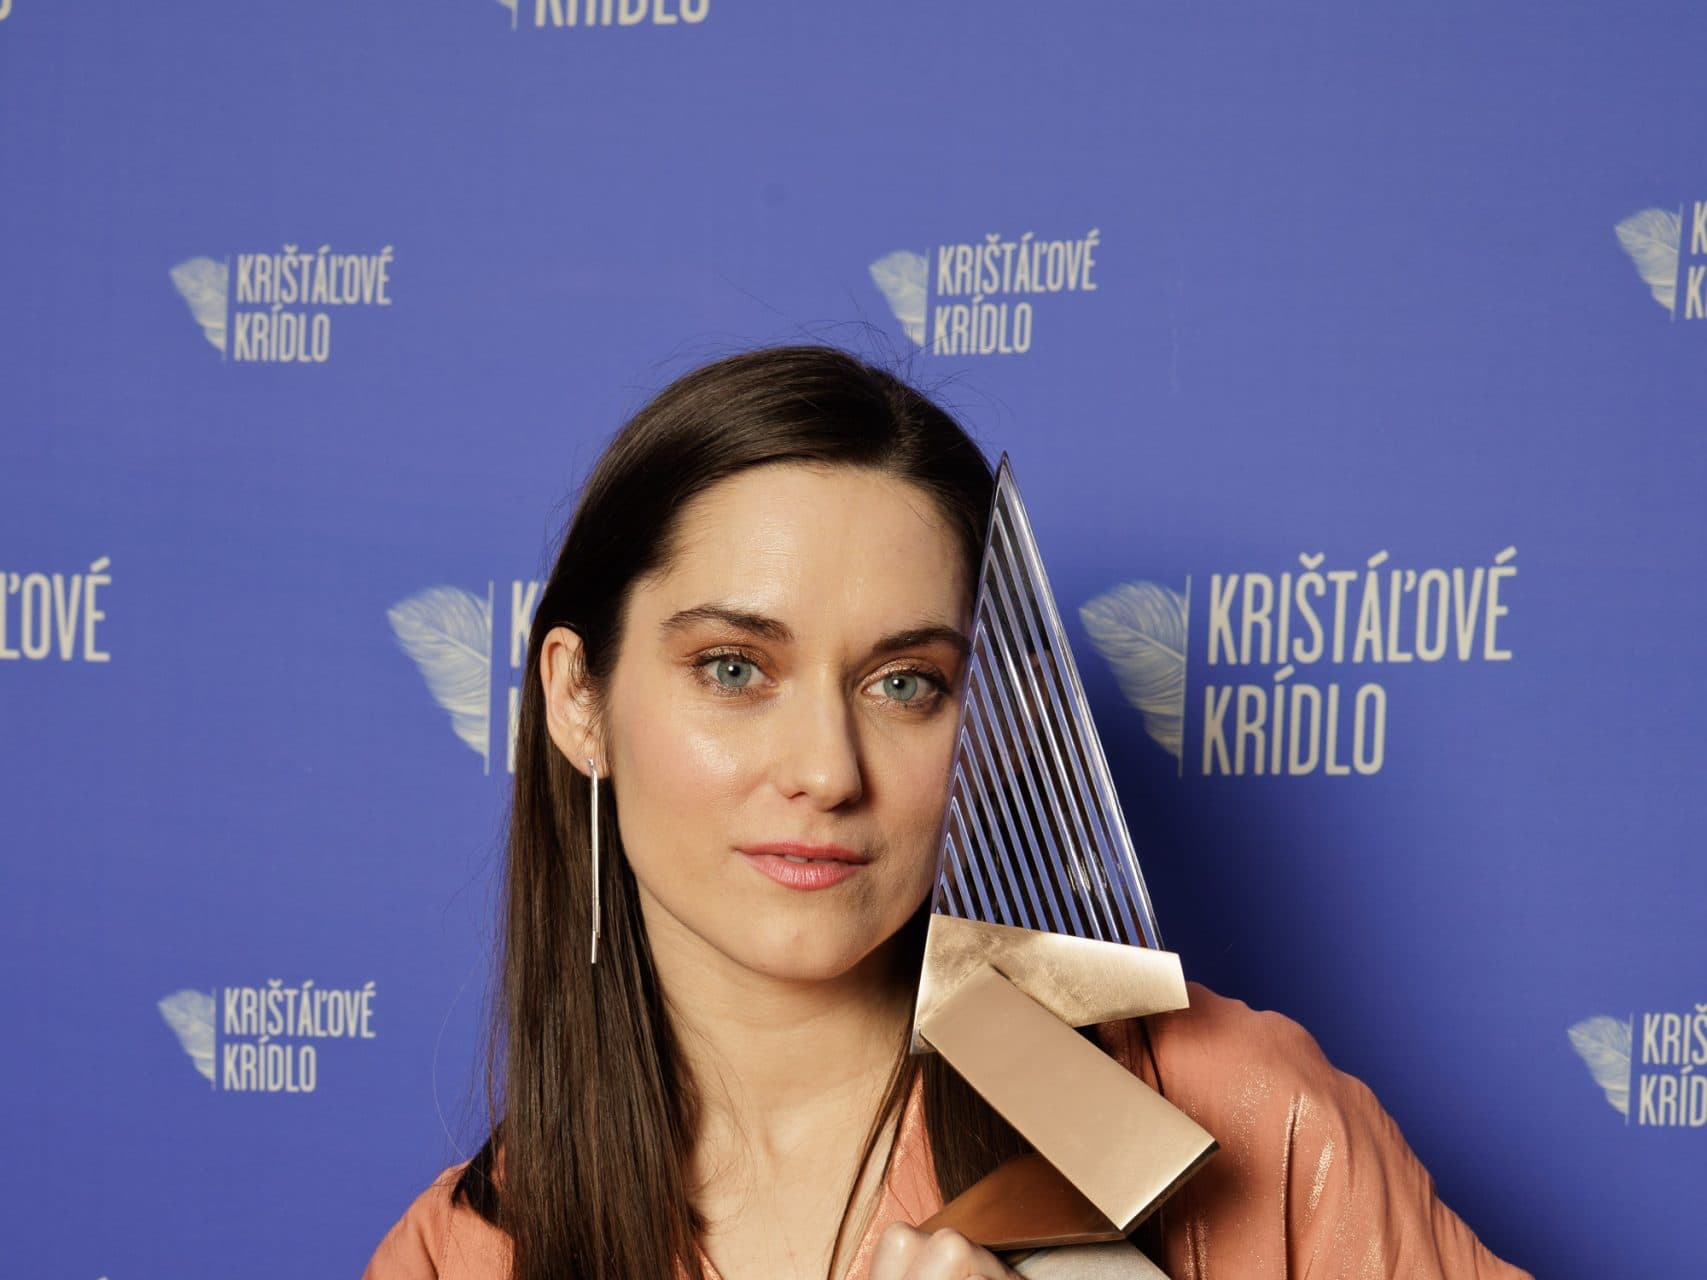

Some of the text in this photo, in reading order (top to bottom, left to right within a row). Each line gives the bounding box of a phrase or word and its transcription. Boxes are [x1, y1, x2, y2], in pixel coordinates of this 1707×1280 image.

[236, 244, 393, 305] KRIŠTÁĽOVÉ
[936, 229, 1100, 296] KRIŠTÁĽOVÉ
[233, 304, 330, 362] KRÍDLO
[933, 296, 1033, 355] KRÍDLO
[1206, 547, 1517, 665] KRIŠTÁĽOVÉ
[1202, 665, 1387, 776] KRÍDLO
[224, 979, 376, 1038] KRIŠTÁĽOVÉ
[223, 1036, 317, 1093] KRÍDLO
